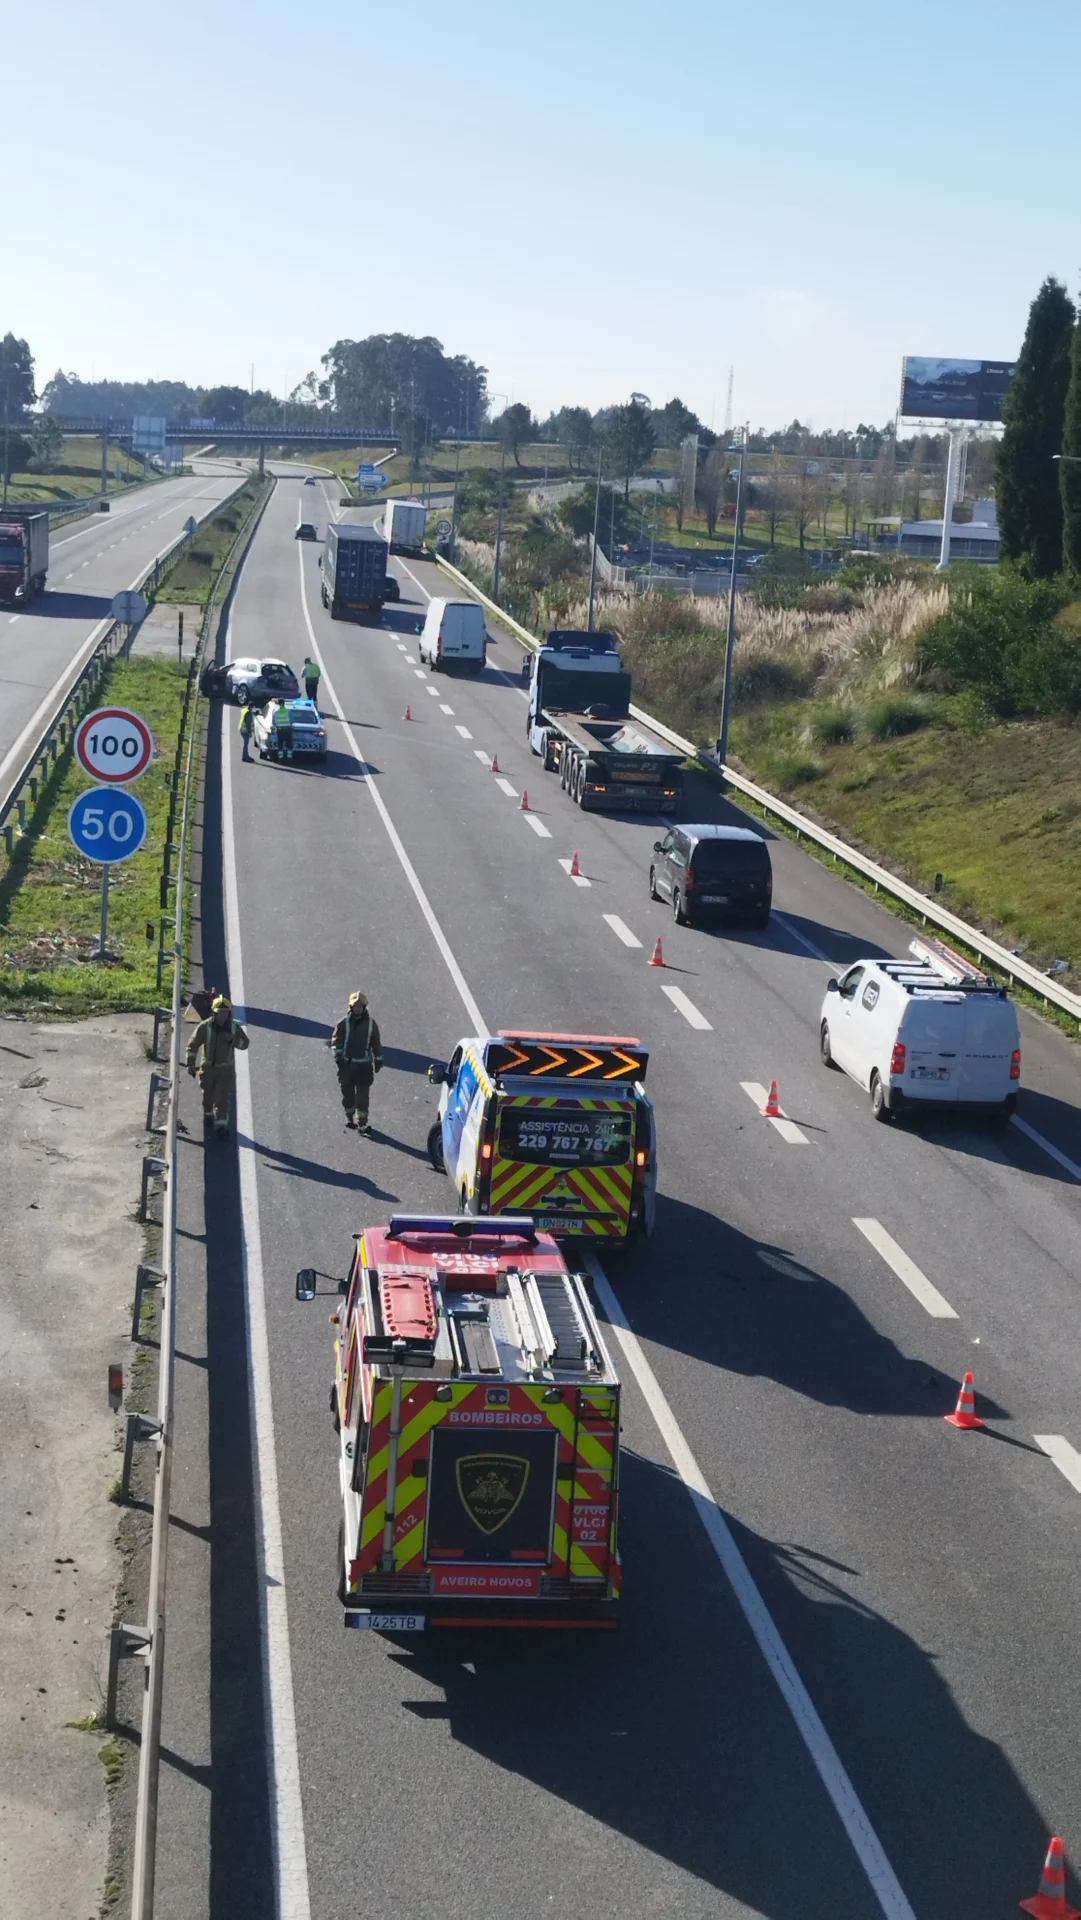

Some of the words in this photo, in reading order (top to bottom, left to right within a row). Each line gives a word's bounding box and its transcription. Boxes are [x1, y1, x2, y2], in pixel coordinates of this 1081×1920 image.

[89, 734, 139, 758] 100
[81, 808, 133, 842] 50
[519, 1121, 590, 1134] ASSISTÊNCIA
[518, 1134, 547, 1148] 229
[552, 1136, 580, 1150] 767
[584, 1138, 612, 1152] 767
[449, 1411, 543, 1424] BOMBEIROS
[396, 1513, 417, 1533] 112
[573, 1517, 606, 1528] VLCI
[580, 1530, 597, 1540] 02
[440, 1576, 487, 1586] AVEIRO
[490, 1577, 532, 1587] NOVOS
